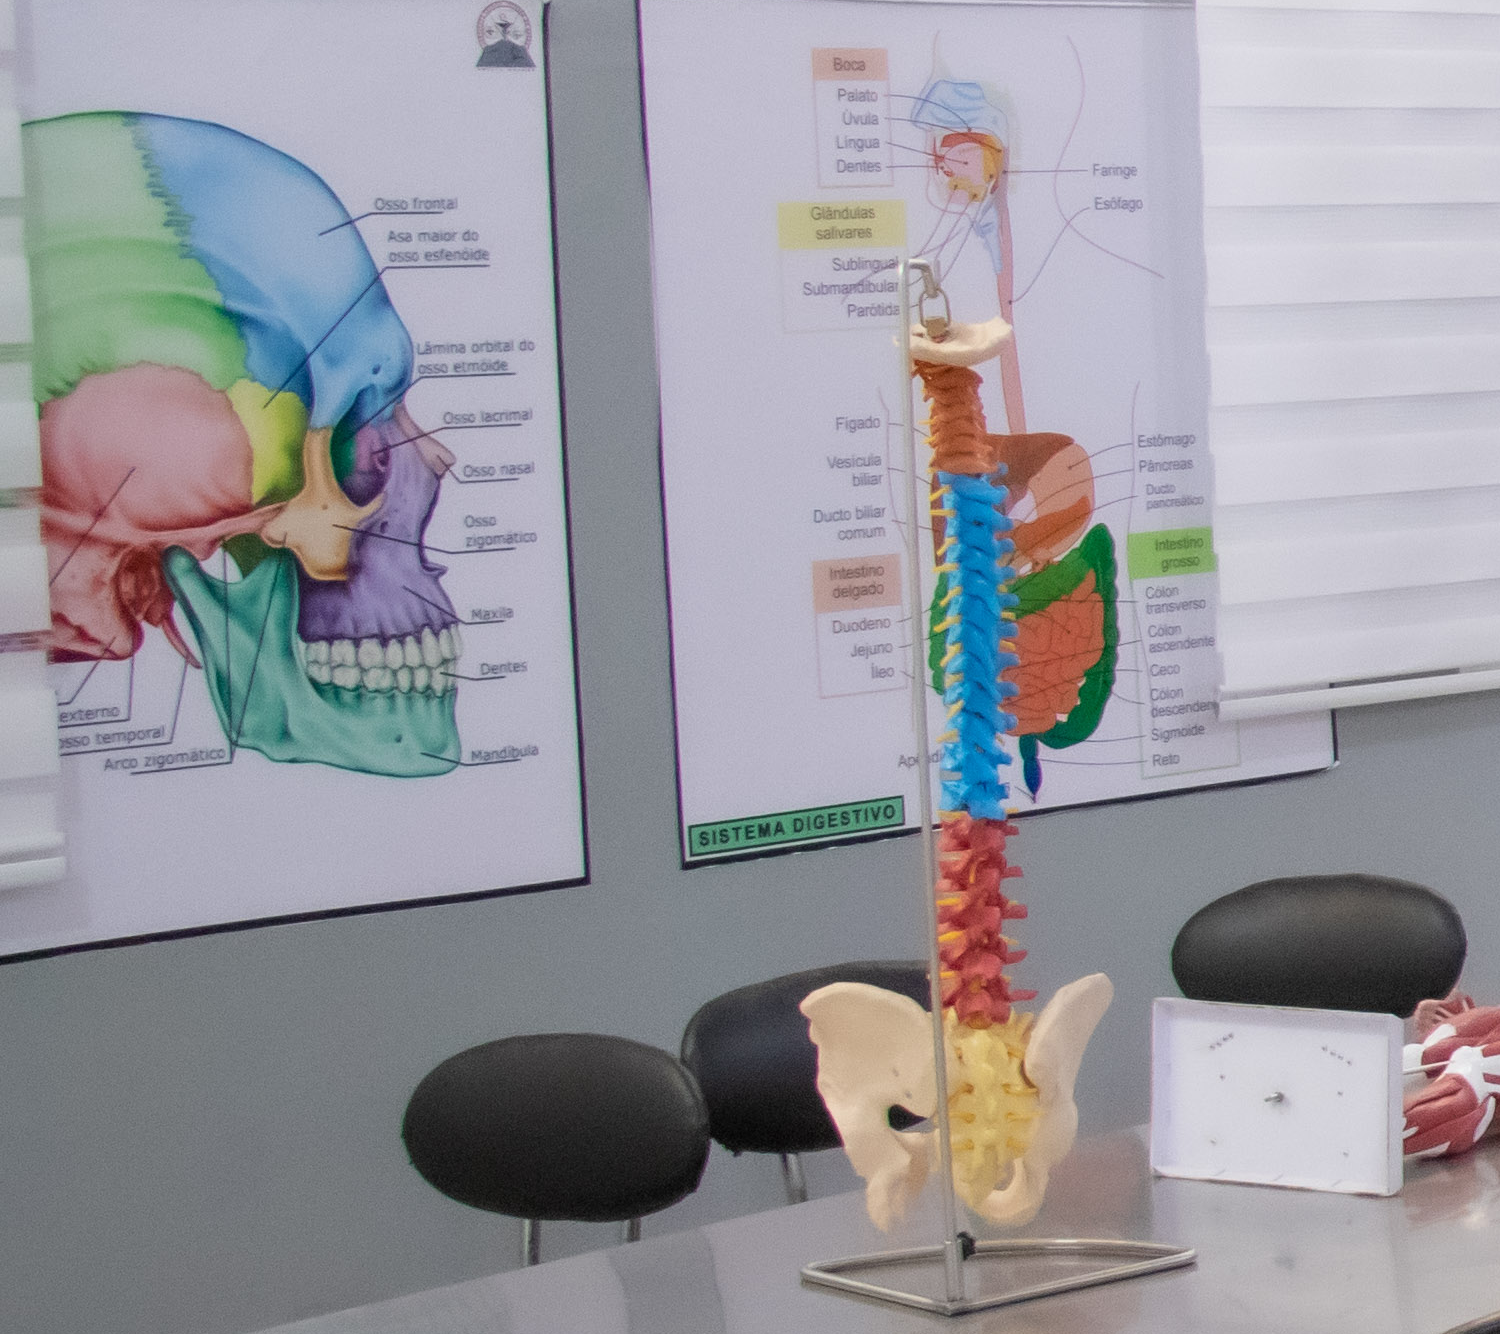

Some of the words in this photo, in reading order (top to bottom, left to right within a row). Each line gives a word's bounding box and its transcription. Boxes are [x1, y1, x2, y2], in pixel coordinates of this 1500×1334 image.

[833, 57, 866, 71] Boca
[838, 88, 878, 102] Palato
[842, 109, 879, 126] Úvula
[835, 135, 880, 152] Língua
[836, 159, 882, 173] Dentes
[1093, 163, 1138, 180] Faringe
[374, 197, 408, 211] Osso
[413, 197, 458, 210] frontal
[811, 206, 876, 220] Glândulas
[387, 230, 413, 243] Asa
[418, 230, 458, 242] maior
[461, 229, 480, 242] do
[816, 226, 873, 240] salivares
[388, 251, 419, 262] osso
[424, 248, 490, 261] esfenóide
[832, 256, 899, 272] Sublingual
[803, 279, 899, 296] Submandibular
[847, 301, 900, 318] Parótida
[416, 341, 466, 355] Lâmina
[471, 340, 514, 353] orbital
[518, 339, 536, 352] do
[417, 364, 448, 375] osso
[453, 360, 509, 372] etmóide
[443, 411, 477, 425] Osso
[480, 408, 533, 423] lacrimal
[835, 416, 881, 433] Fígado
[1137, 433, 1196, 449] Estômago
[827, 454, 882, 469] Vesícula
[1138, 458, 1194, 473] Pâncreas
[463, 464, 496, 478] Osso
[500, 462, 536, 475] nasal
[852, 472, 883, 487] biliar
[1146, 483, 1176, 496] Ducto
[464, 515, 497, 528] Osso
[813, 508, 852, 523] Ducto
[855, 505, 886, 520] biliar
[465, 532, 538, 549] zigomático
[838, 526, 886, 541] comum
[1155, 537, 1204, 552] Intestino
[1161, 555, 1201, 572] grosso
[829, 564, 885, 581] Intestino
[832, 583, 885, 601] delgado
[1145, 585, 1179, 600] Cólon
[471, 607, 514, 620] Maxila
[1146, 598, 1207, 615] transverso
[832, 618, 891, 634] Duodeno
[1148, 623, 1182, 638] Cólon
[850, 643, 893, 660] Jejuno
[1149, 635, 1216, 654] ascendente
[480, 661, 528, 675] Dentes
[1150, 663, 1181, 677] Ceco
[1150, 686, 1184, 701] Cólon
[59, 706, 121, 723] externo
[1151, 700, 1218, 718] descenden
[96, 725, 166, 747] temporal
[103, 757, 138, 771] Arco
[144, 747, 227, 768] zigomático
[471, 745, 539, 762] Mandíbula
[1152, 753, 1180, 767] Reto
[699, 821, 786, 847] SISTEMA
[793, 804, 896, 834] DIGESTIVO
